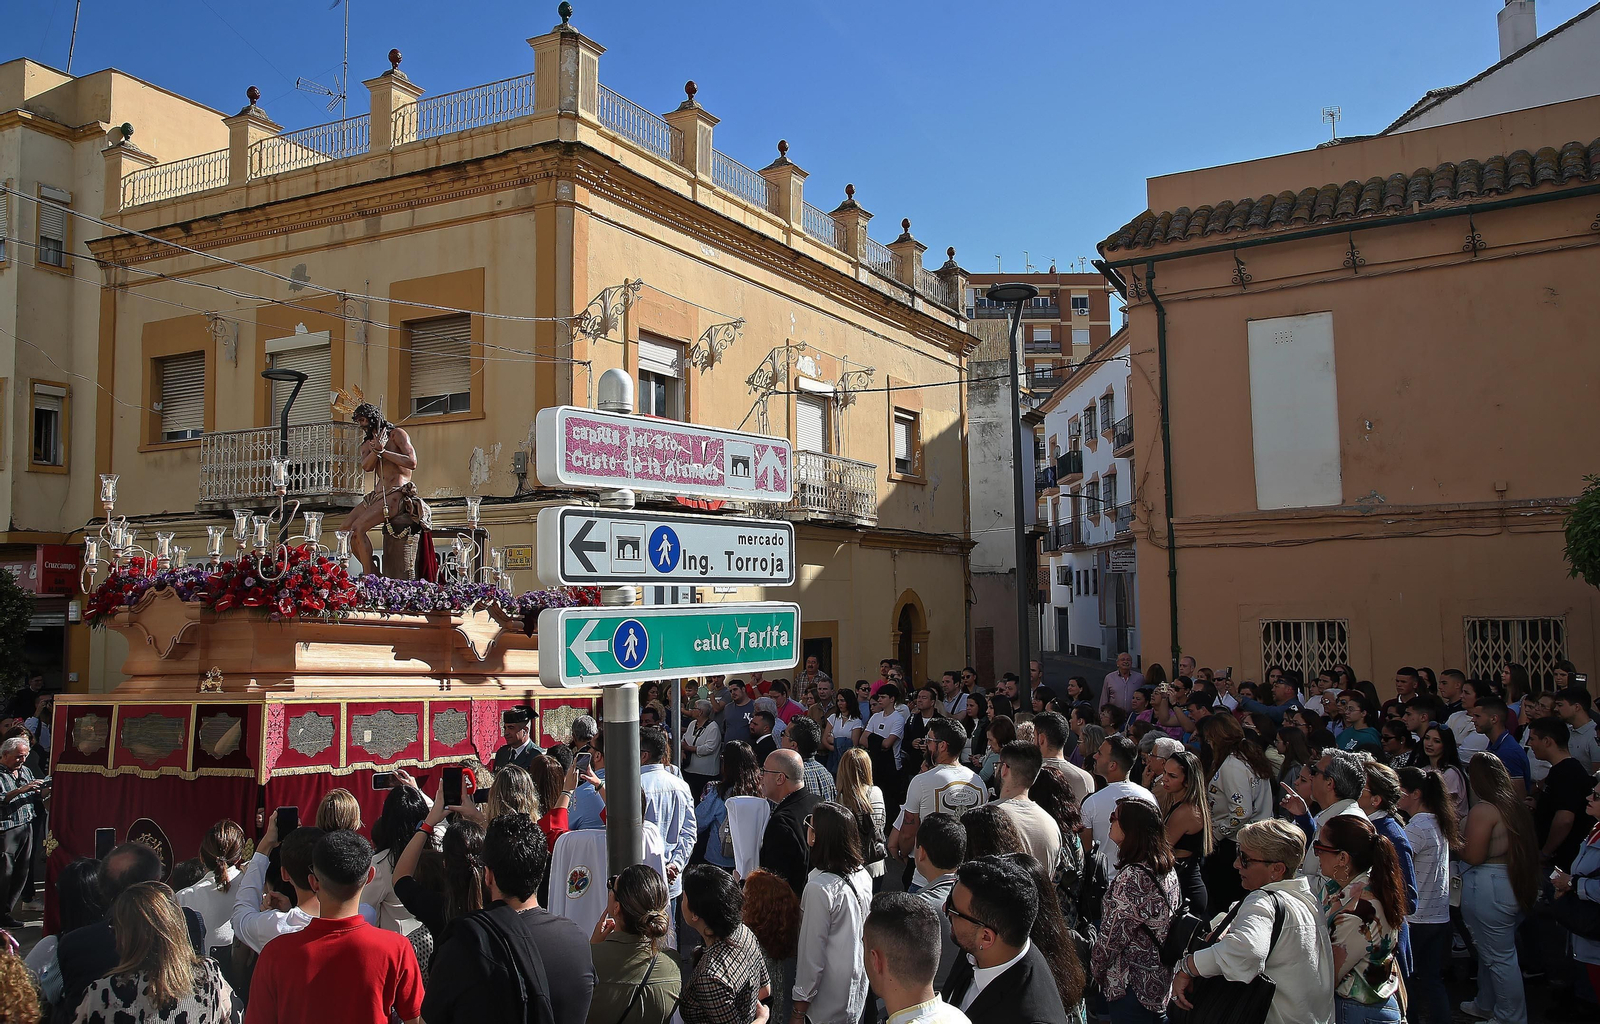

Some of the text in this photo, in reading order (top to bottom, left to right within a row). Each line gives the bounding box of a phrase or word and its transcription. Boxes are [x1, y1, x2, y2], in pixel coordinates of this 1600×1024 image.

[571, 451, 617, 471] Cristo
[738, 533, 784, 546] mercado
[44, 561, 76, 570] Cruzcampo
[682, 549, 784, 577] Ing. Torroja
[693, 624, 789, 652] calle Tarifa
